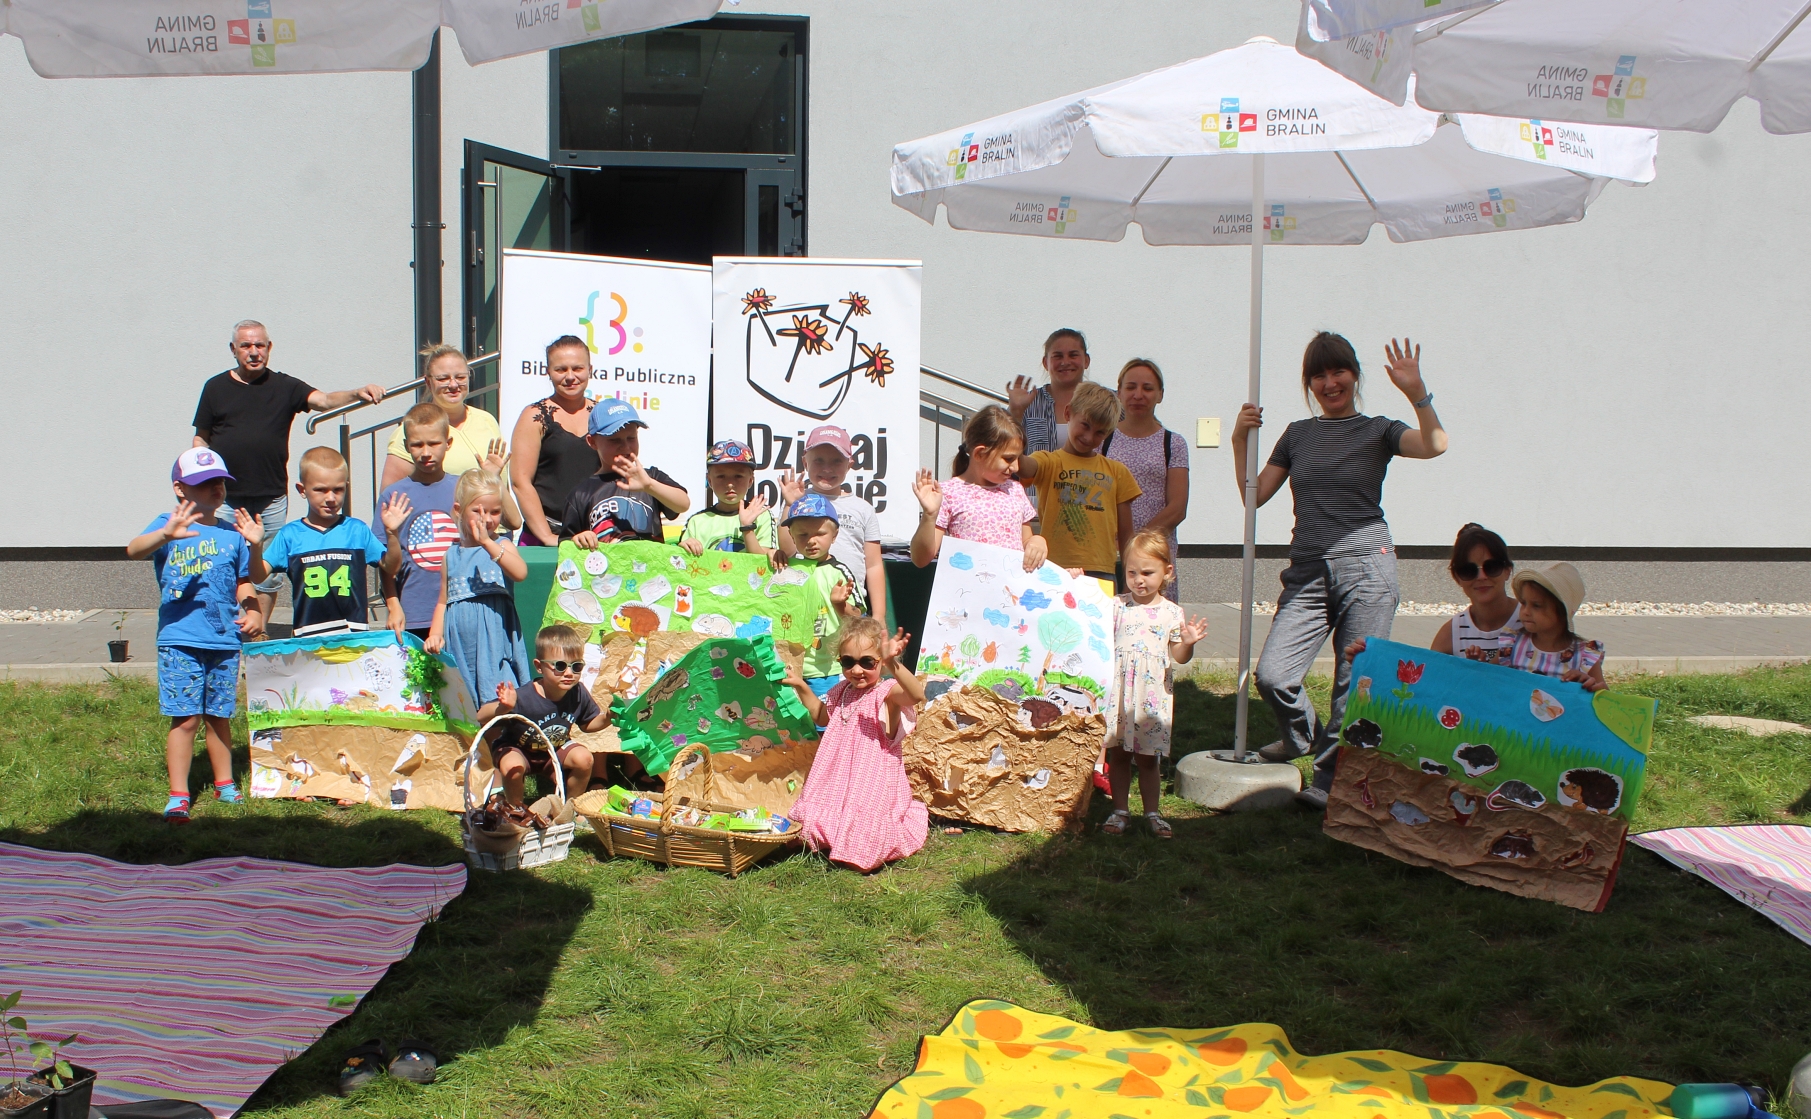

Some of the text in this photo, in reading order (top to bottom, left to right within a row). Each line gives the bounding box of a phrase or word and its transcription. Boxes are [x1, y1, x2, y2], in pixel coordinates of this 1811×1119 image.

[1266, 108, 1318, 121] GMINA
[1266, 123, 1326, 136] BRALIN
[1556, 126, 1587, 144] GMINA
[984, 133, 1013, 149] GMINA
[981, 147, 1015, 164] BRALIN
[1559, 141, 1594, 159] BRALIN
[521, 361, 696, 386] Bibka Publiczna
[746, 423, 887, 480] Dziaj
[199, 537, 219, 557] Out
[301, 553, 352, 564] URBAN FUSION
[303, 564, 352, 599] 94
[537, 712, 557, 726] AND
